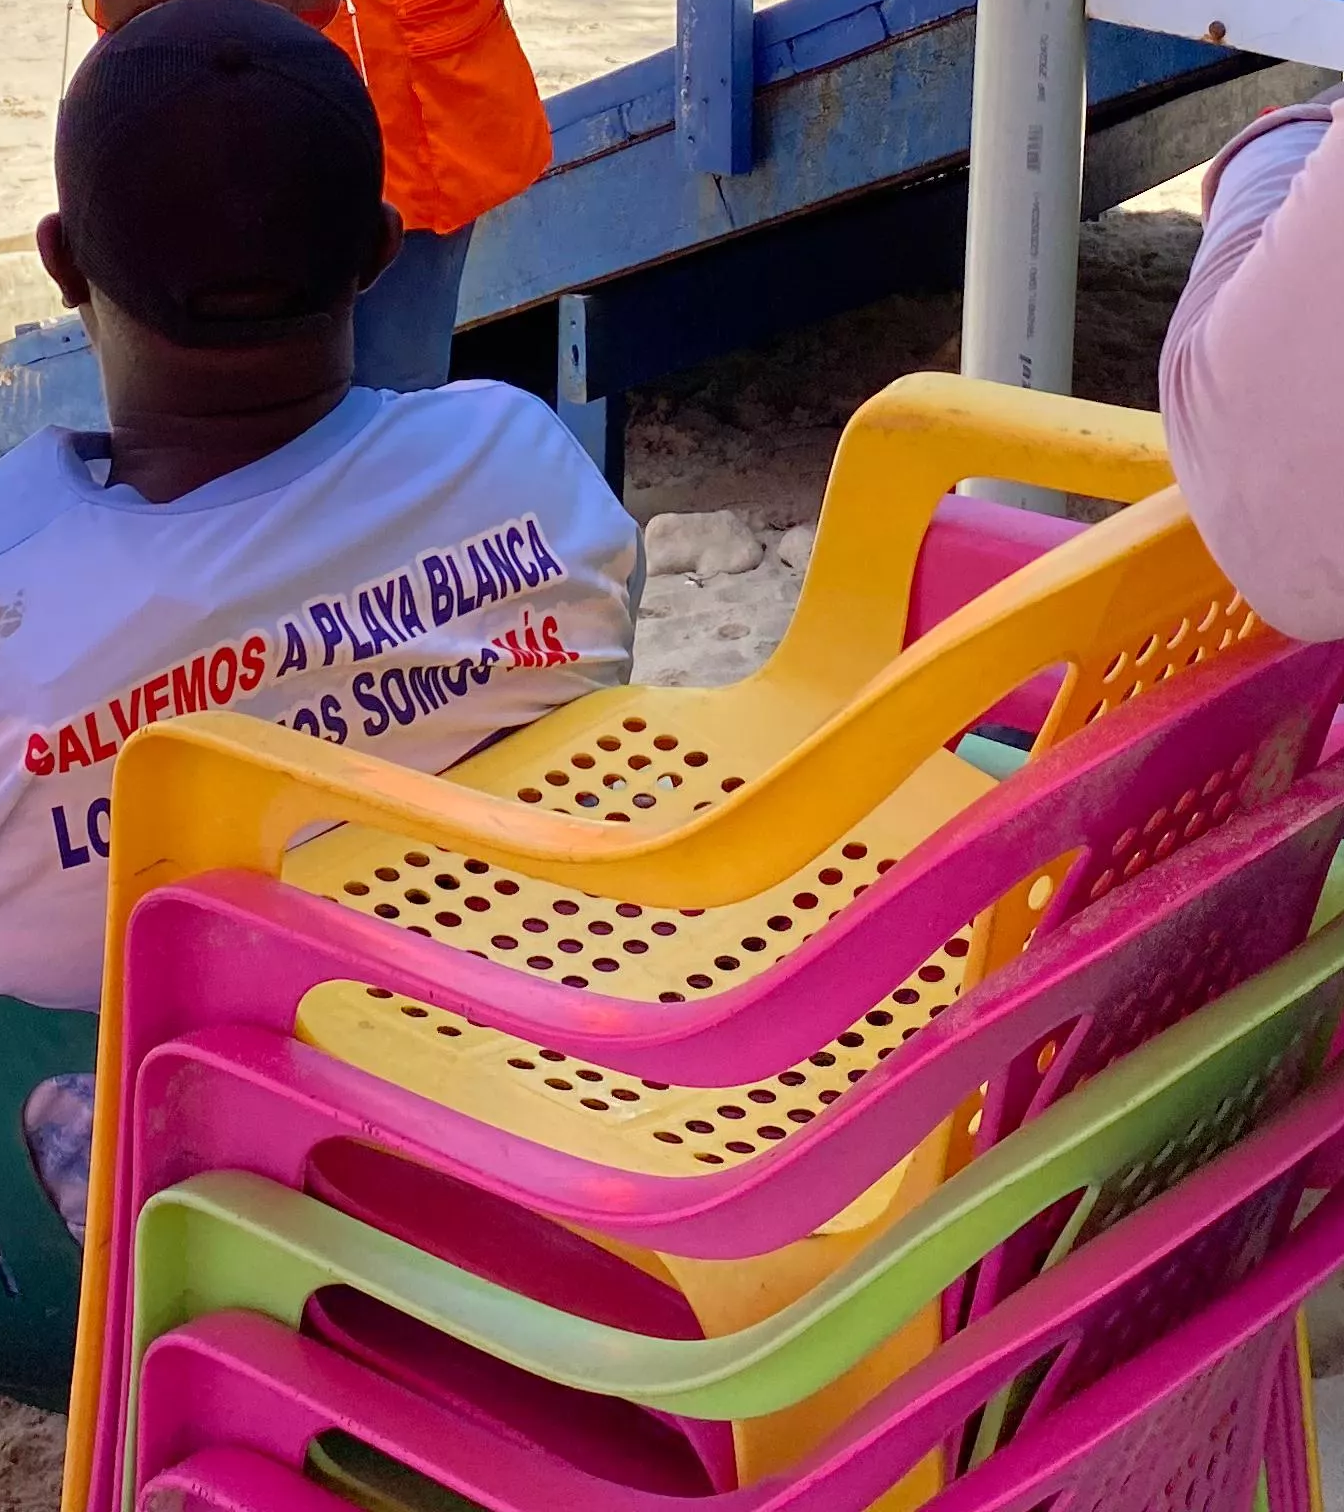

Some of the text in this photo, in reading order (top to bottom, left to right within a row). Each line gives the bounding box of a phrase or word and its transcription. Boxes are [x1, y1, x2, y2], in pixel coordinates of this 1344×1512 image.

[25, 520, 564, 776] SALVEMOS A PLAYA BLANCA
